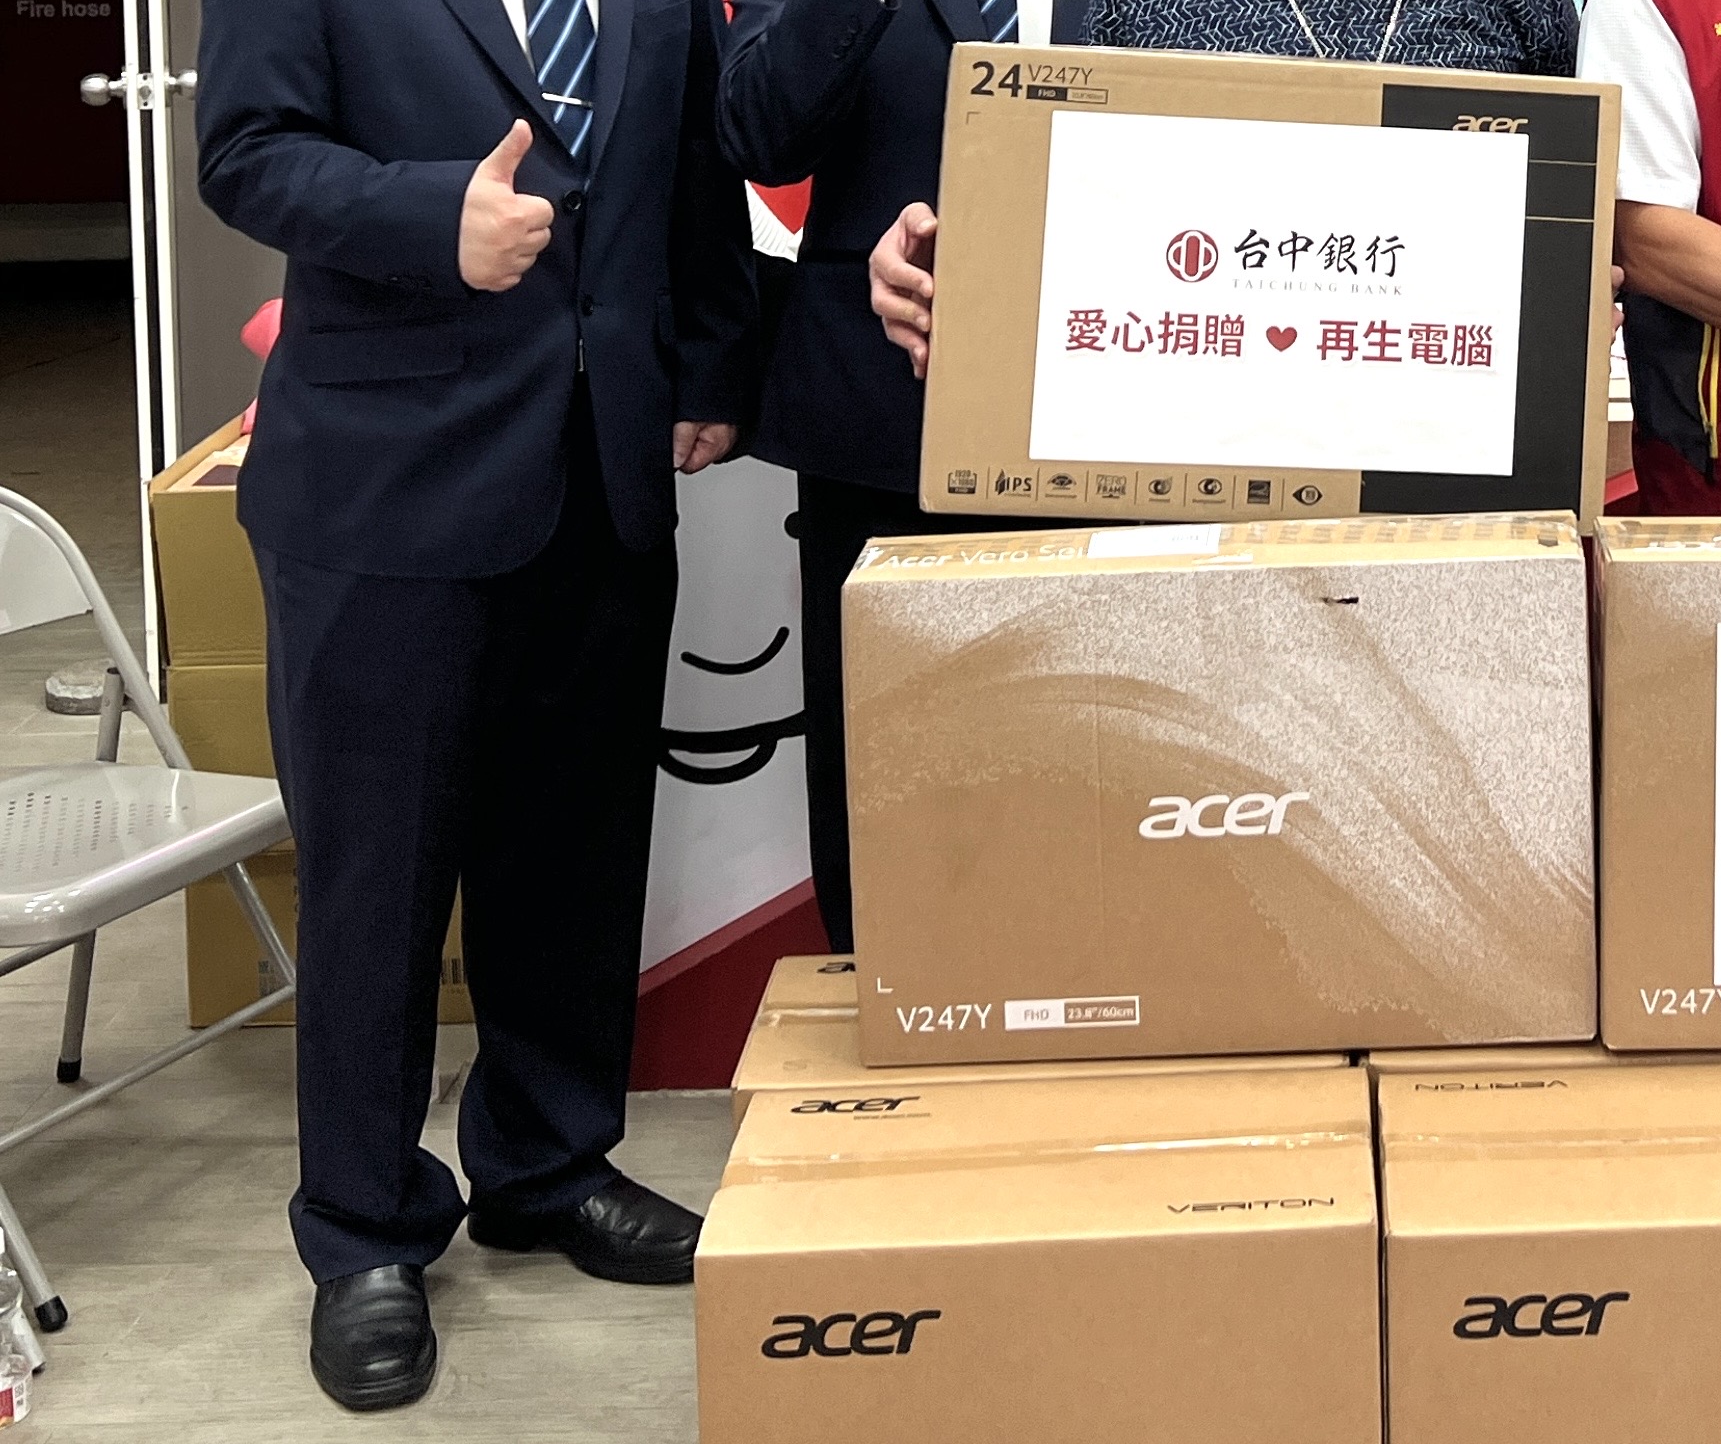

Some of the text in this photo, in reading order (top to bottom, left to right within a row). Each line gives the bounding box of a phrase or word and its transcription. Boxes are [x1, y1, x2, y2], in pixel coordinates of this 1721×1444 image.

[17, 0, 111, 17] Fire hose
[970, 61, 1093, 97] 24 V247Y
[1453, 115, 1528, 133] acer
[1233, 228, 1406, 277] 台中銀行
[1232, 278, 1402, 295] TAICHUNG BANK
[1065, 308, 1493, 367] 愛心捐贈 再生電腦
[1006, 477, 1032, 492] IPS
[1138, 791, 1309, 839] acer
[896, 1003, 992, 1033] V247Y
[1024, 1009, 1049, 1022] FHD
[791, 1096, 921, 1114] acer
[1167, 1197, 1334, 1214] VERITON
[1452, 1291, 1630, 1340] acer
[760, 1309, 942, 1359] acer
